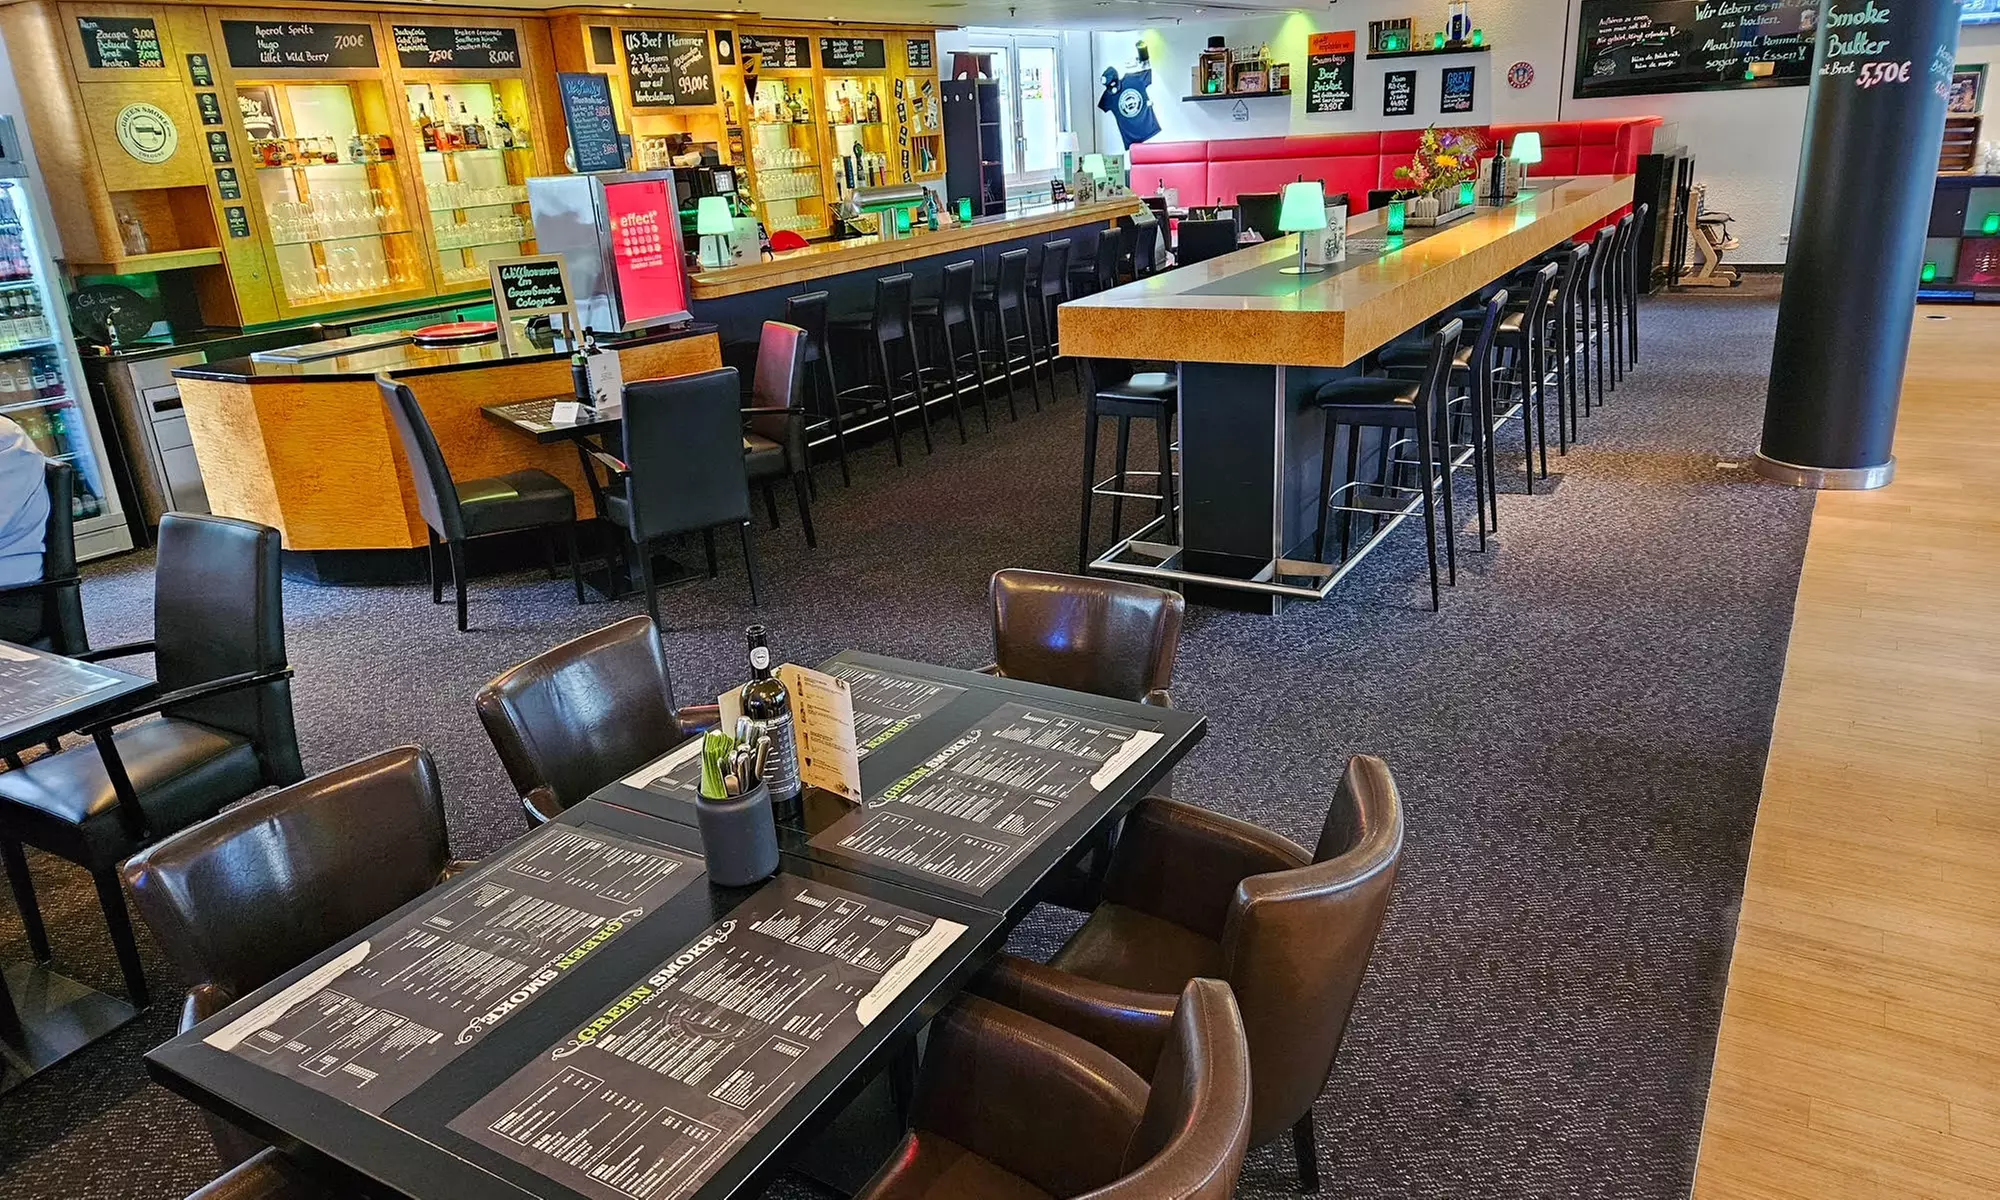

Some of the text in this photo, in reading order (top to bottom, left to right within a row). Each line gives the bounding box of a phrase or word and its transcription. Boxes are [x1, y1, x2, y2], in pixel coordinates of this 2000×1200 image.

[1695, 2, 1717, 21] Wir
[1717, 1, 1752, 17] lieben
[1826, 0, 1890, 29] Smoke
[255, 24, 315, 38] Aperol Spritz
[1721, 21, 1737, 29] zu
[257, 39, 280, 53] Hugo
[333, 34, 365, 50] 7,00€
[625, 31, 704, 51] US Beef Hammer
[1701, 36, 1759, 52] Manchmal
[1762, 33, 1801, 47] kommt
[1827, 30, 1890, 58] Butter
[285, 51, 305, 63] Wild
[306, 50, 330, 63] Berry
[428, 49, 454, 63] 7,50€
[488, 49, 515, 64] 8,00€
[1705, 57, 1739, 72] sogar
[1317, 67, 1340, 80] Beef
[1830, 60, 1856, 76] Brot
[1855, 60, 1912, 89] 5,50€
[678, 74, 710, 95] 99,00€
[1311, 80, 1344, 93] Brisket
[121, 106, 170, 128] GREEN SMOKE
[502, 265, 560, 280] Willkommen
[516, 296, 556, 309] Cologne
[883, 738, 972, 800] GREEN SMOKE
[555, 920, 624, 971] GREEN
[527, 952, 566, 979] COLOGNE
[480, 968, 559, 1025] SMOKE
[577, 985, 652, 1042] GREEN
[648, 935, 719, 988] SMOKE
[641, 977, 679, 1005] COLOGNE
